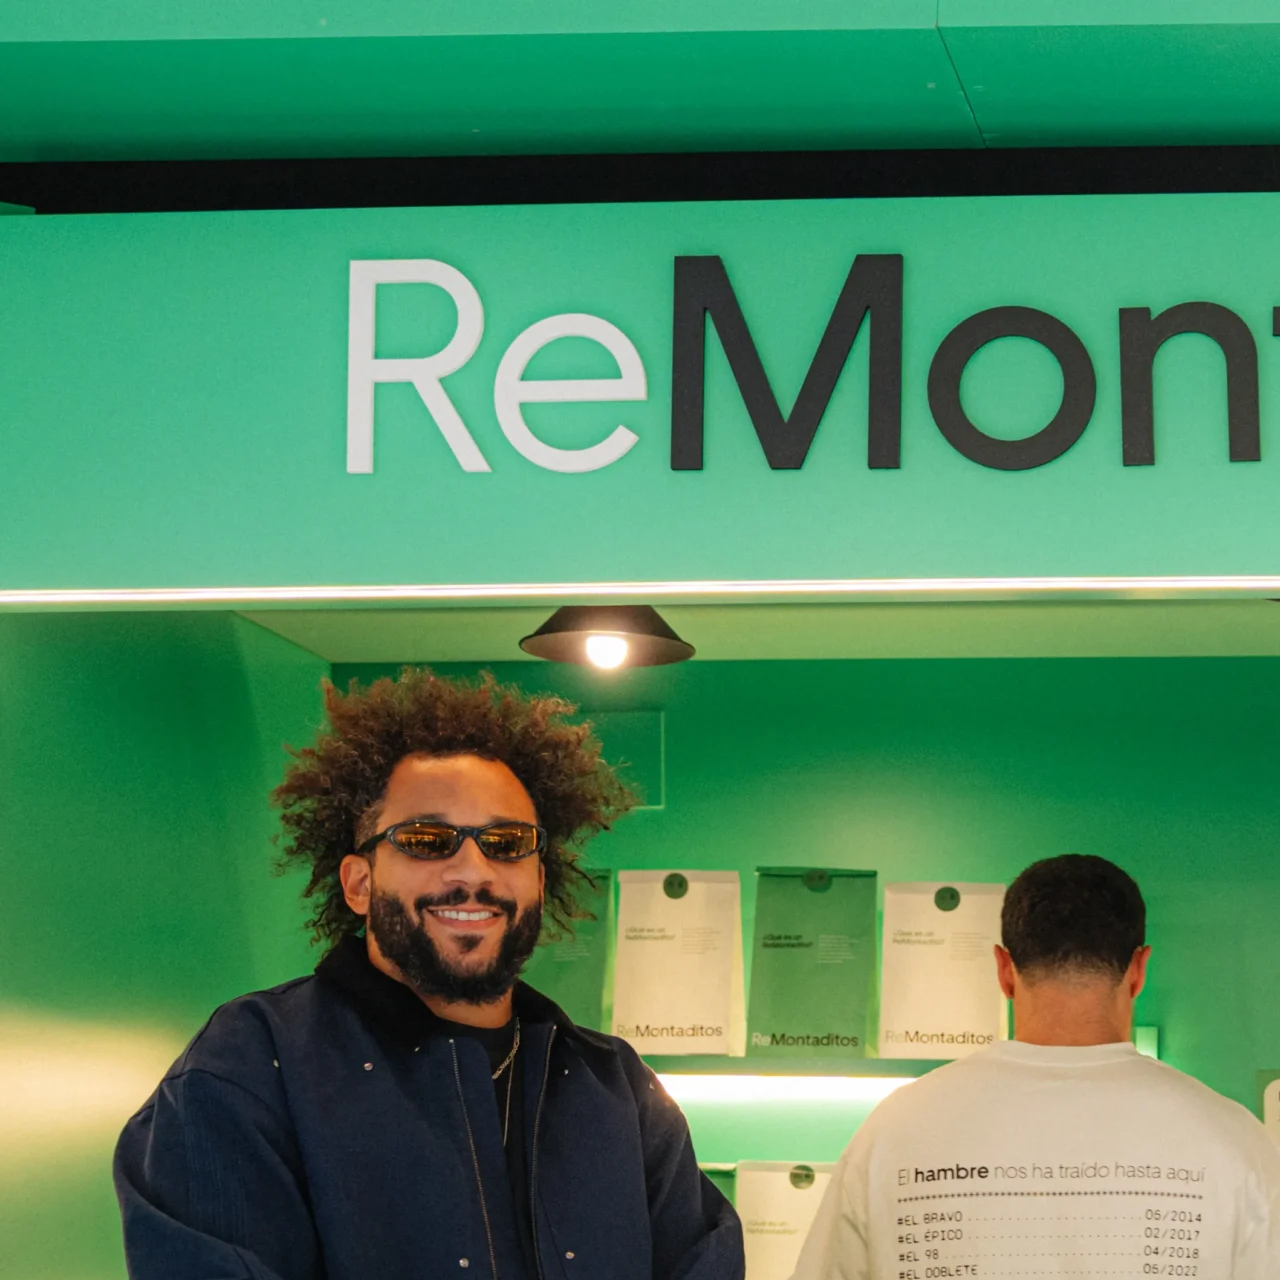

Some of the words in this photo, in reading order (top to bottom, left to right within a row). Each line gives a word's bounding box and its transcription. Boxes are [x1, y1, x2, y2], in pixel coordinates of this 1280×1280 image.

[617, 1024, 723, 1038] ReMontaditos
[885, 1030, 994, 1046] ReMontaditos
[751, 1032, 859, 1048] ReMontaditos
[898, 1169, 910, 1186] El
[914, 1164, 989, 1183] hambre
[994, 1166, 1028, 1179] nos
[1032, 1163, 1054, 1179] ha
[1059, 1162, 1110, 1179] traído
[1115, 1162, 1162, 1179] hasta
[1166, 1167, 1206, 1184] aquí
[923, 1211, 963, 1225] BRAVO
[1145, 1209, 1202, 1223] 05/2014
[924, 1228, 963, 1242] ÉPICO
[1144, 1227, 1200, 1241] 02/2017
[924, 1249, 940, 1260] 98
[1143, 1245, 1199, 1259] 04/2018
[925, 1264, 978, 1279] DOBLETE
[1143, 1263, 1198, 1277] 05/2022
